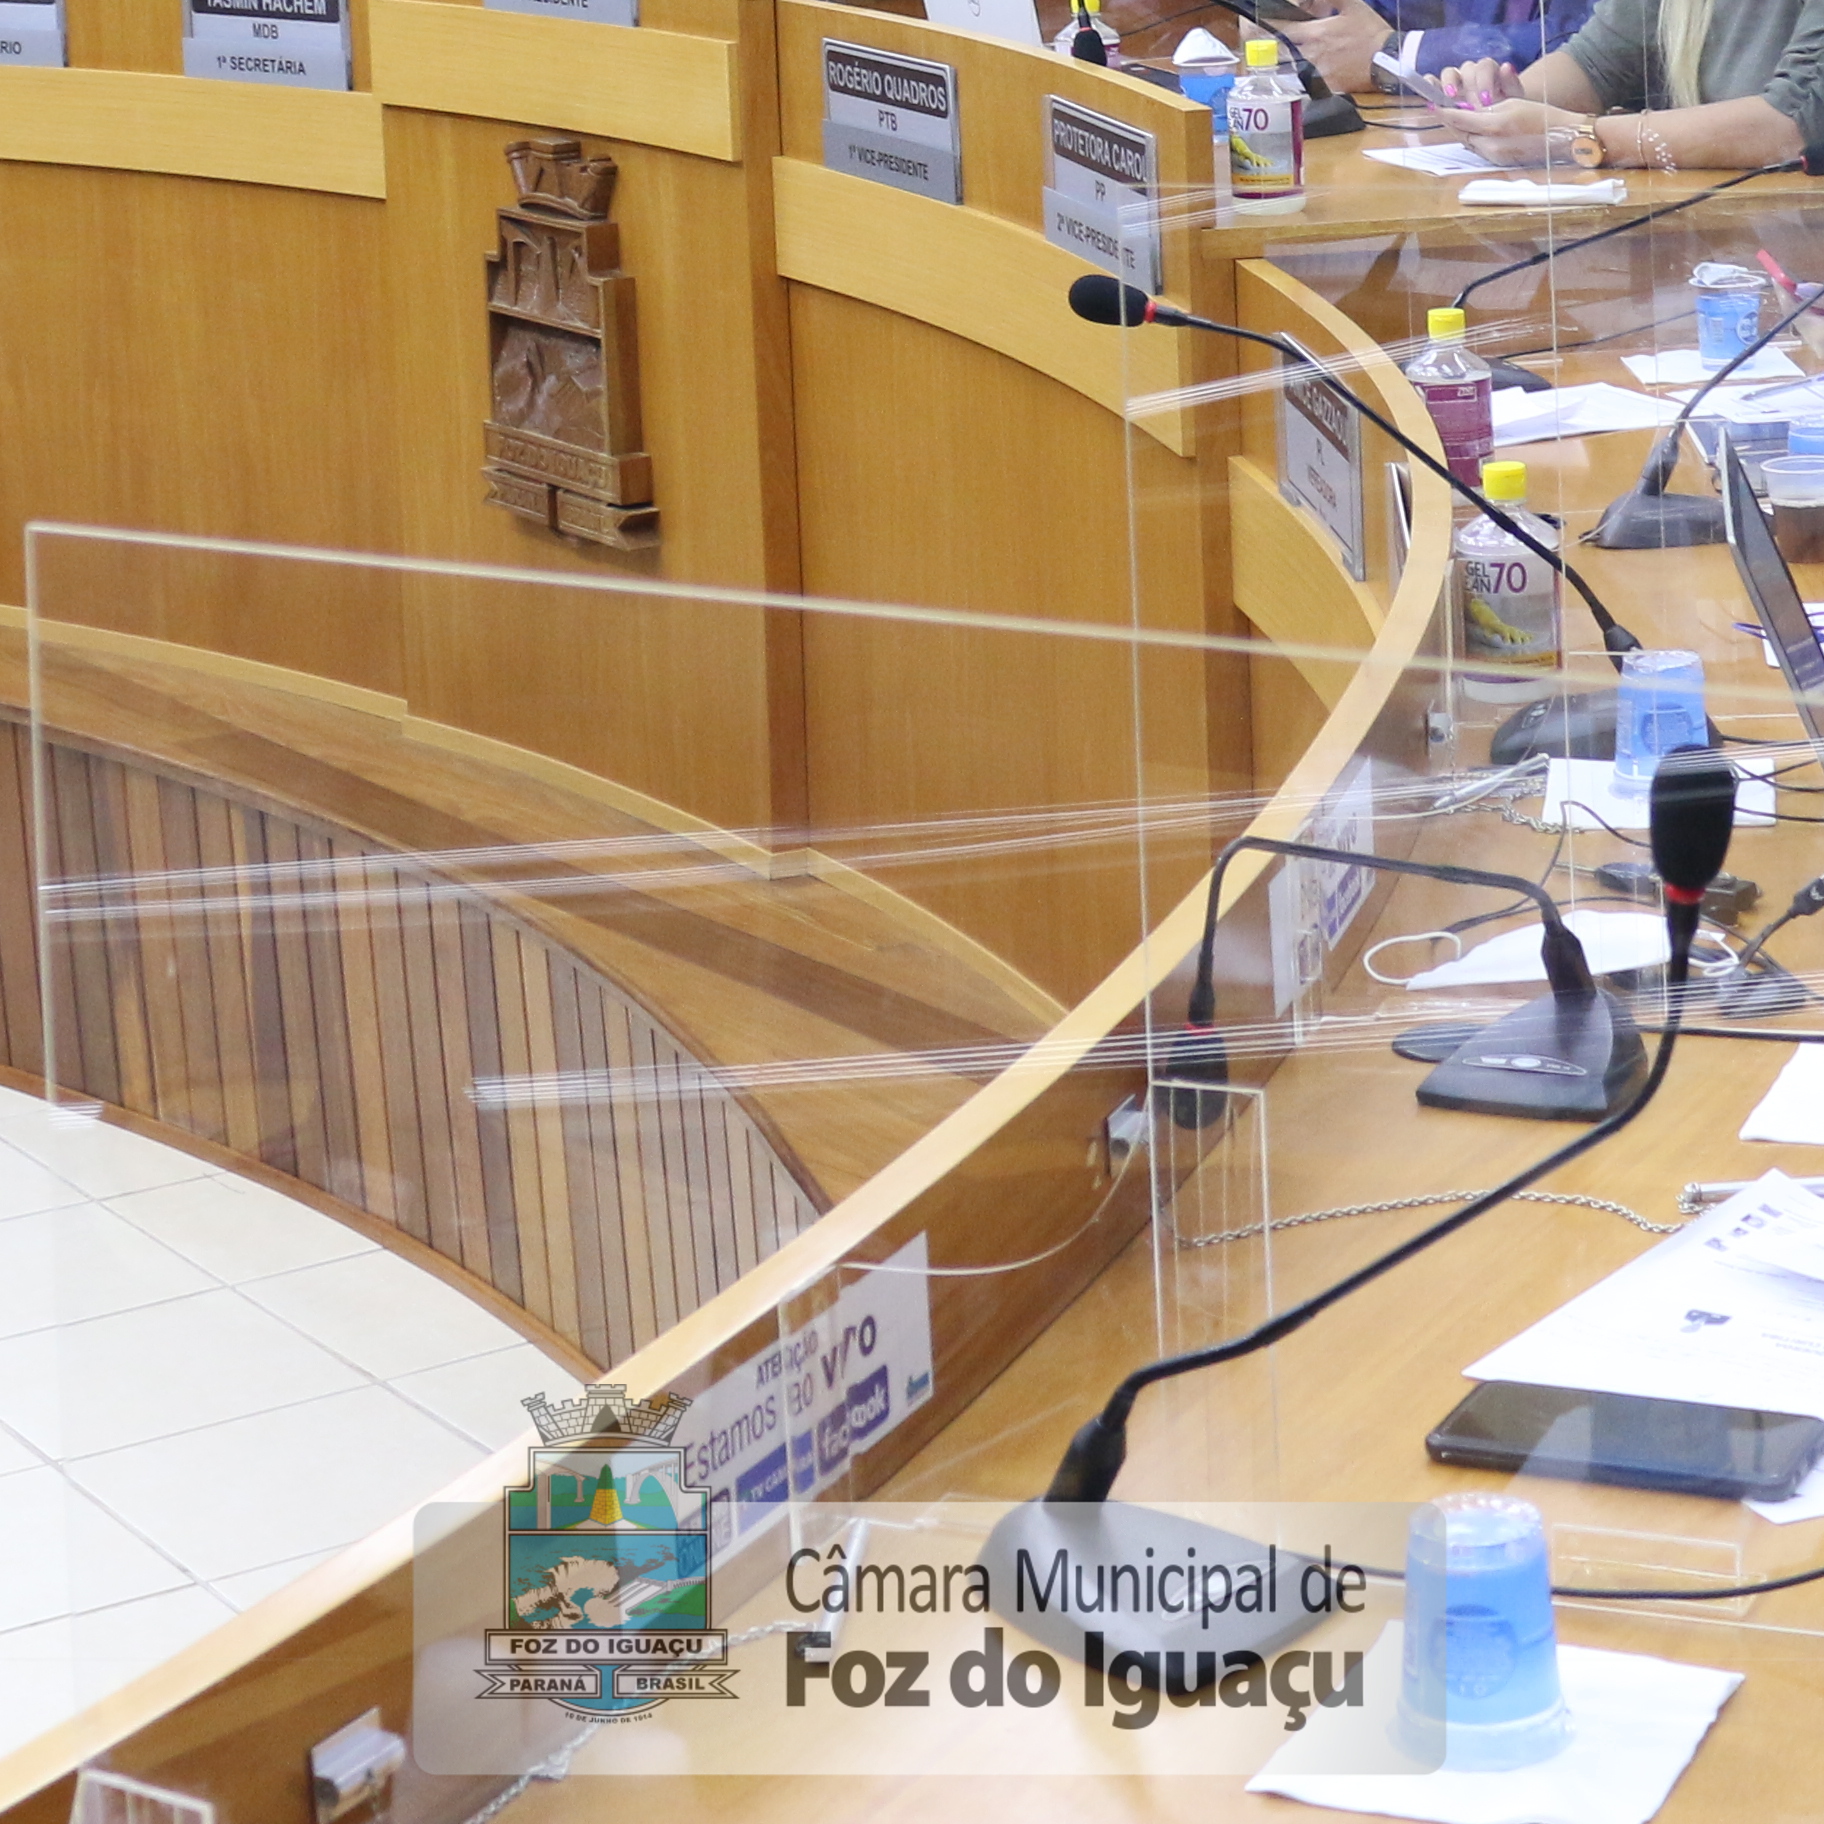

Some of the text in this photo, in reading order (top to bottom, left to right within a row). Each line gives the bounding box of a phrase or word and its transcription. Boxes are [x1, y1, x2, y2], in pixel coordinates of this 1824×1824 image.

[252, 22, 279, 40] MDB
[230, 55, 307, 76] SECRETÁRIA
[828, 60, 947, 112] ROGÉRIO QUADROS
[878, 110, 898, 131] PTB
[1242, 108, 1269, 131] 70
[1053, 118, 1111, 168] PROTETORA
[858, 147, 929, 180] VICE-PRESIDENTE
[1465, 561, 1528, 594] GEL 70
